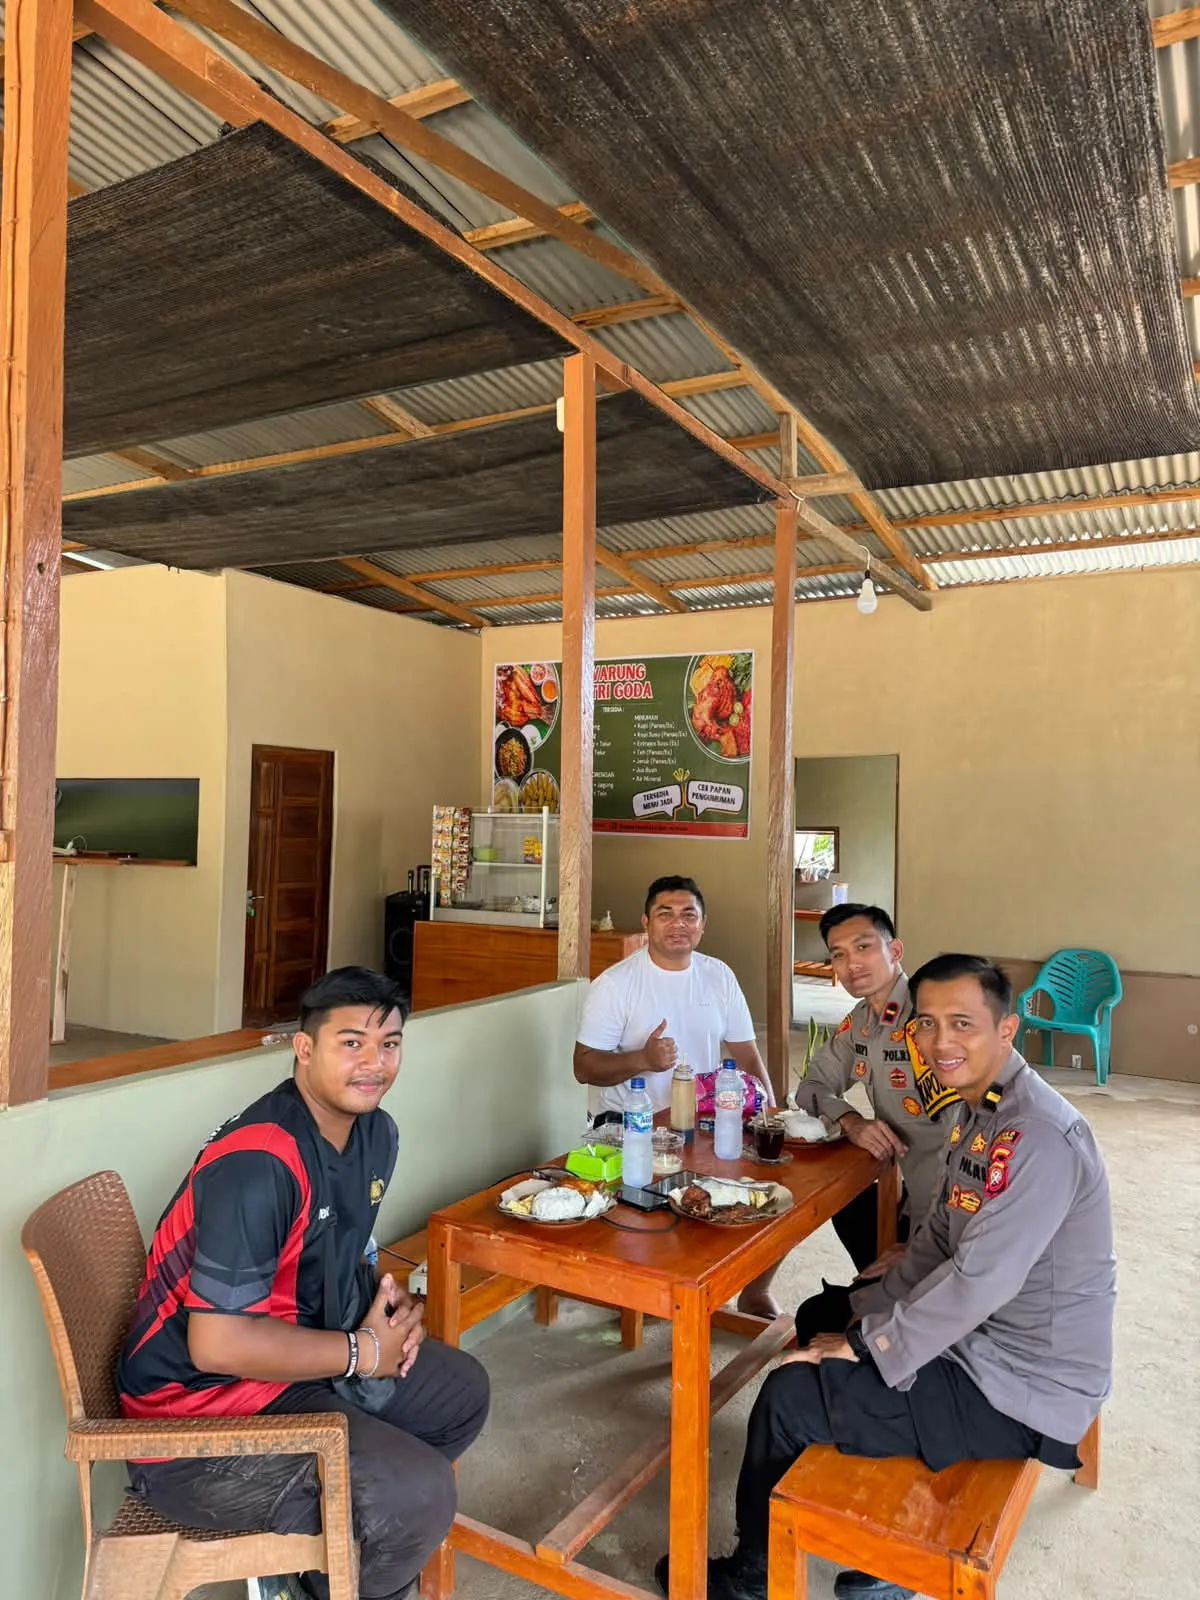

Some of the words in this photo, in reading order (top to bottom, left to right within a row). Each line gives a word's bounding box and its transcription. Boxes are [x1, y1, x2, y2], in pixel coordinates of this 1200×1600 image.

[613, 681, 654, 700] GODA
[643, 789, 670, 801] TERSEDIA
[697, 783, 709, 792] CEK
[710, 784, 731, 795] PAPAN
[642, 801, 659, 810] MENU
[660, 798, 673, 807] JADI
[691, 792, 736, 805] PENGUMUMAN
